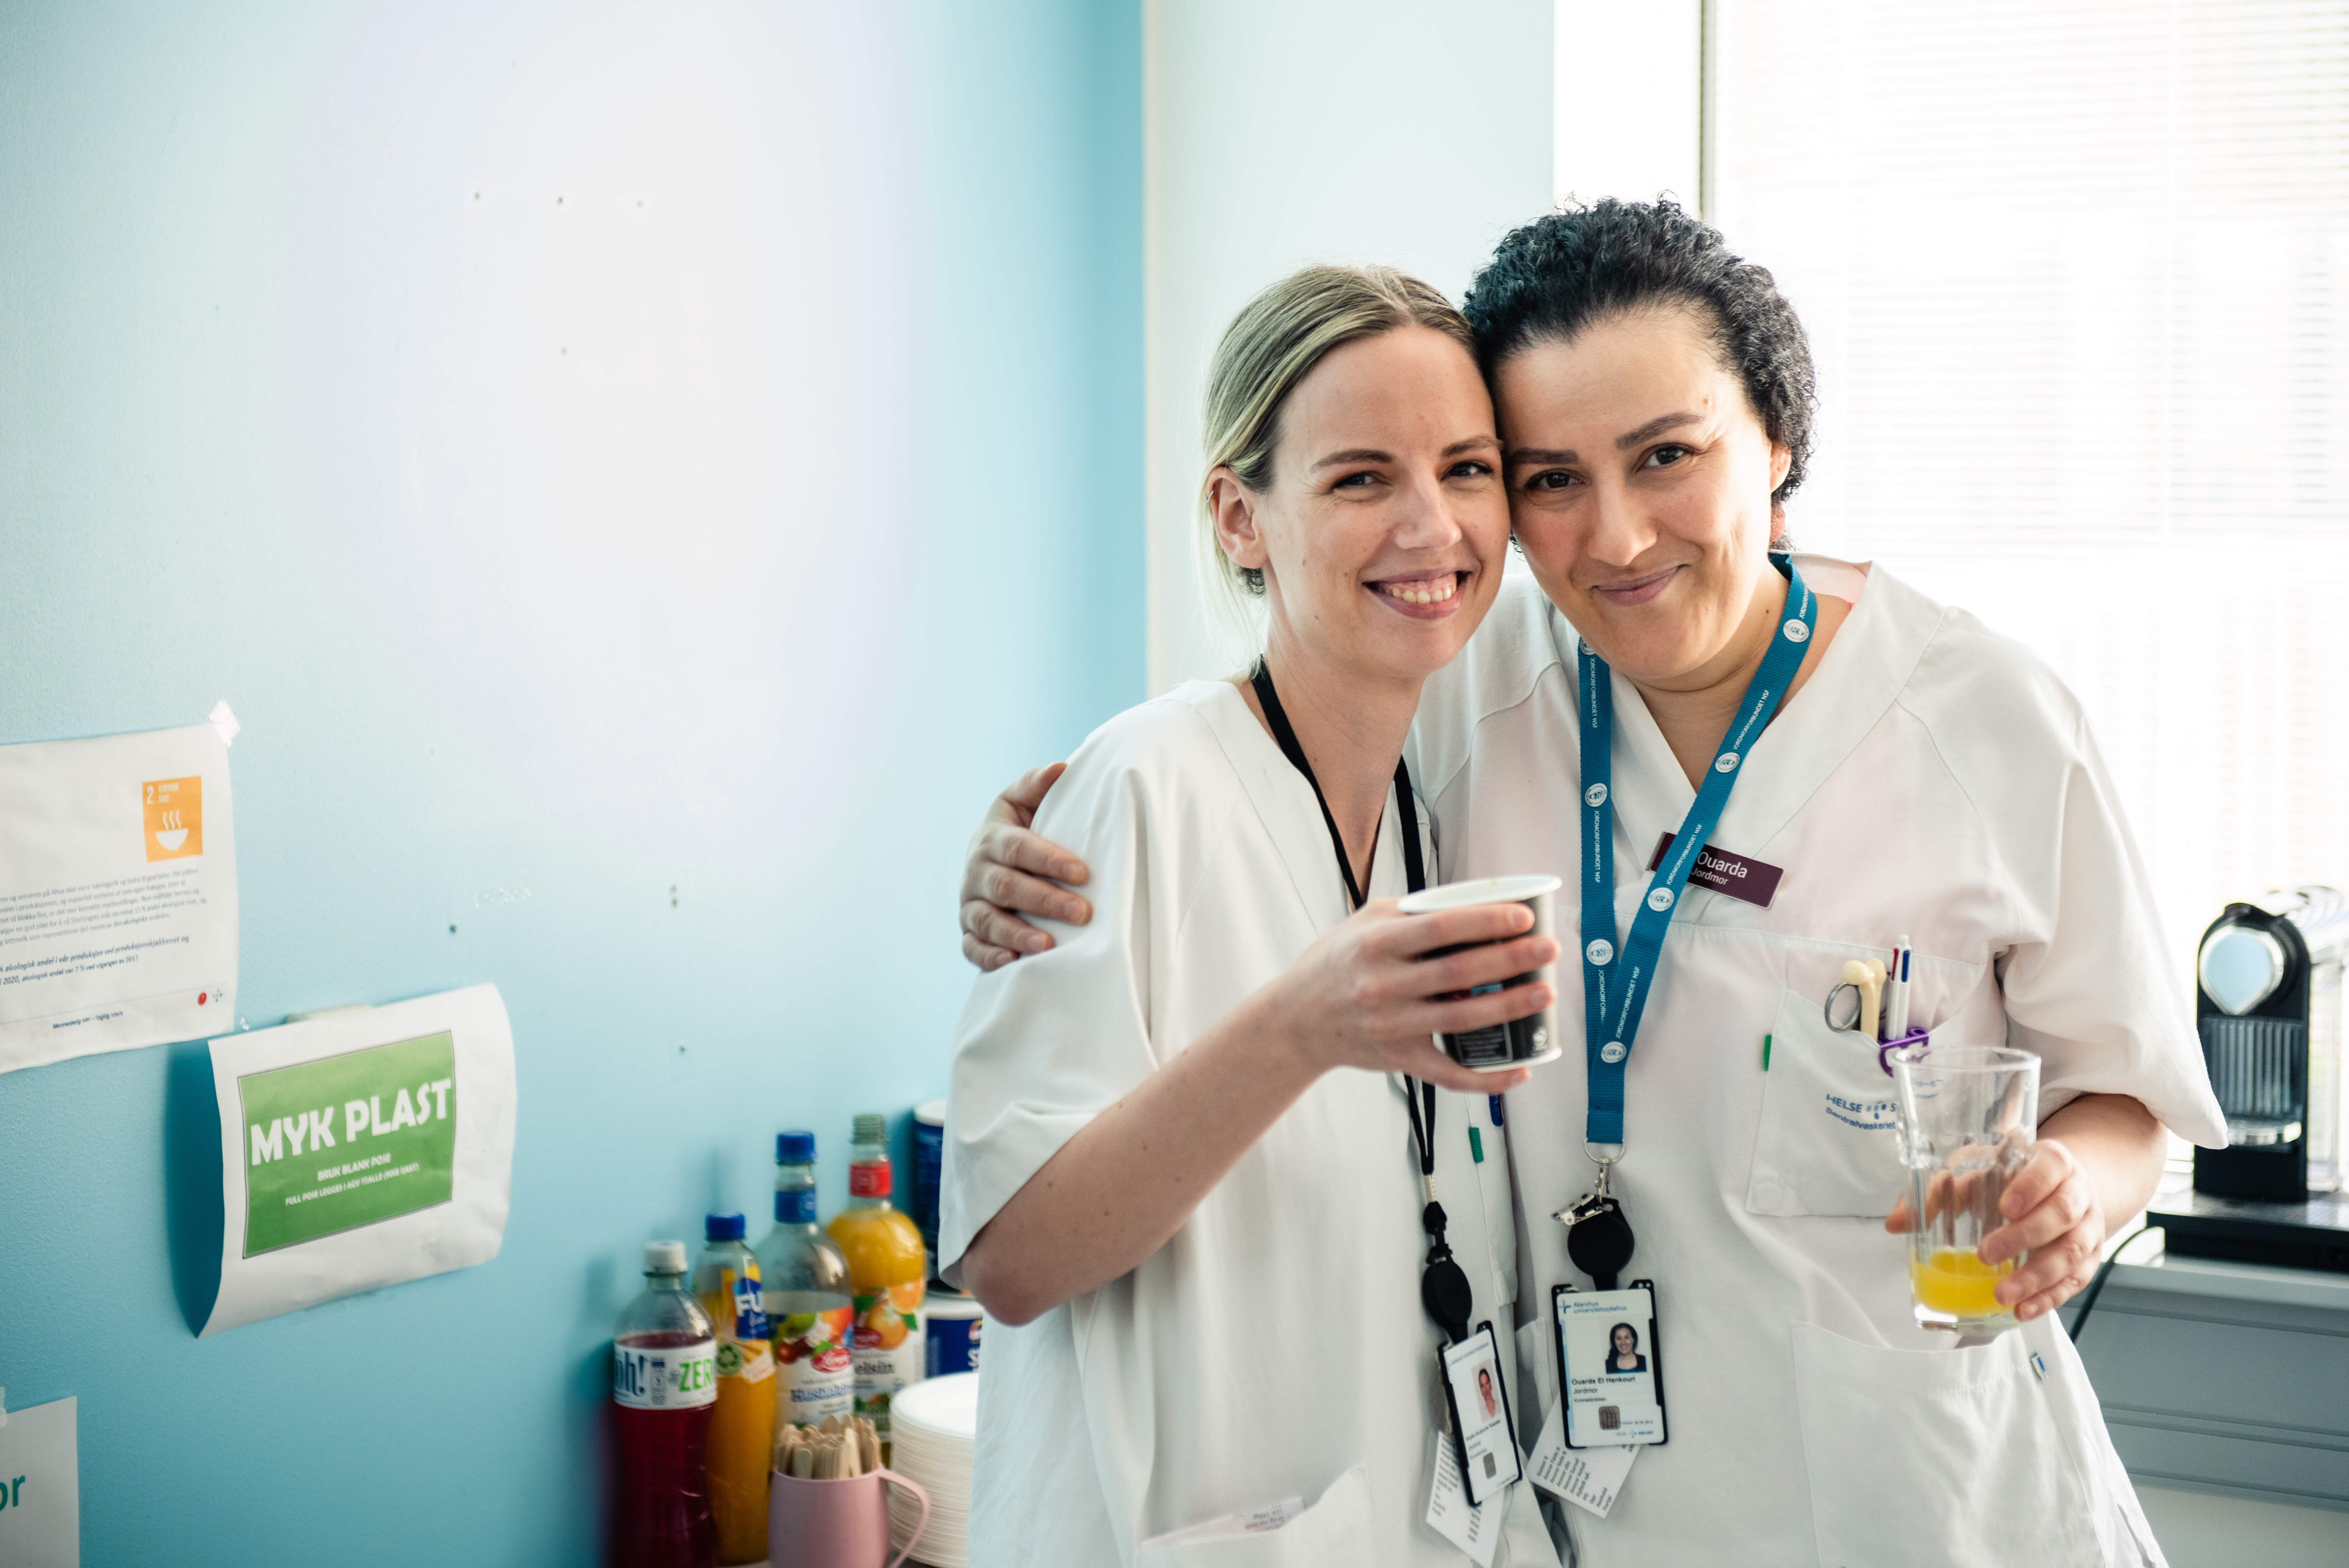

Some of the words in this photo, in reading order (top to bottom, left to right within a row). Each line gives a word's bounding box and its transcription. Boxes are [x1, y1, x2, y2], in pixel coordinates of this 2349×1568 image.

[1733, 700, 1764, 750] JORDMORFORBUNDET
[1761, 690, 1769, 700] NSF
[147, 786, 153, 804] 2
[1666, 834, 1697, 885] JORDMORFORBUNDET
[1697, 852, 1747, 878] Ouarda
[43, 889, 50, 898] på
[91, 879, 118, 889] næringsrik
[147, 874, 156, 883] god
[1691, 868, 1729, 885] Jordmor
[18, 913, 36, 921] klokka
[78, 903, 100, 912] korrekte
[19, 900, 59, 912] produksjonen,
[68, 894, 92, 903] matavfall
[0, 927, 14, 935] ølger
[25, 923, 35, 932] god
[71, 914, 99, 924] Stortingets
[147, 903, 160, 912] andel
[4, 936, 27, 945] lettmelk
[42, 928, 78, 940] representerer
[90, 923, 105, 931] meste
[5, 960, 35, 972] økologisk
[37, 957, 54, 967] andel
[70, 950, 103, 963] produksjon
[105, 946, 114, 955] ved
[181, 935, 189, 944] og
[3, 976, 20, 985] 2020,
[22, 971, 47, 982] økologisk
[96, 959, 118, 969] utgangen
[1616, 980, 1636, 1039] JORDMORFORBUNDET
[53, 1019, 81, 1029] Menneskelig
[1826, 1094, 1862, 1113] HELSE
[250, 1105, 336, 1166] MYK
[344, 1077, 452, 1142] PLAST
[1826, 1107, 1896, 1130] Sentralvaskeriet
[317, 1166, 340, 1182] BRUK
[342, 1158, 370, 1176] BLANK
[371, 1153, 391, 1167] POSE
[285, 1195, 302, 1206] FULL
[302, 1190, 319, 1201] POSE
[1536, 1459, 1546, 1477] Kontor
[1543, 1465, 1553, 1481] Ansvar
[1550, 1468, 1559, 1484] Ansvar
[1556, 1472, 1566, 1488] Ansvar
[1563, 1475, 1573, 1491] Ansvar
[1570, 1479, 1579, 1495] Ansvar
[1596, 1487, 1608, 1508] Renhold
